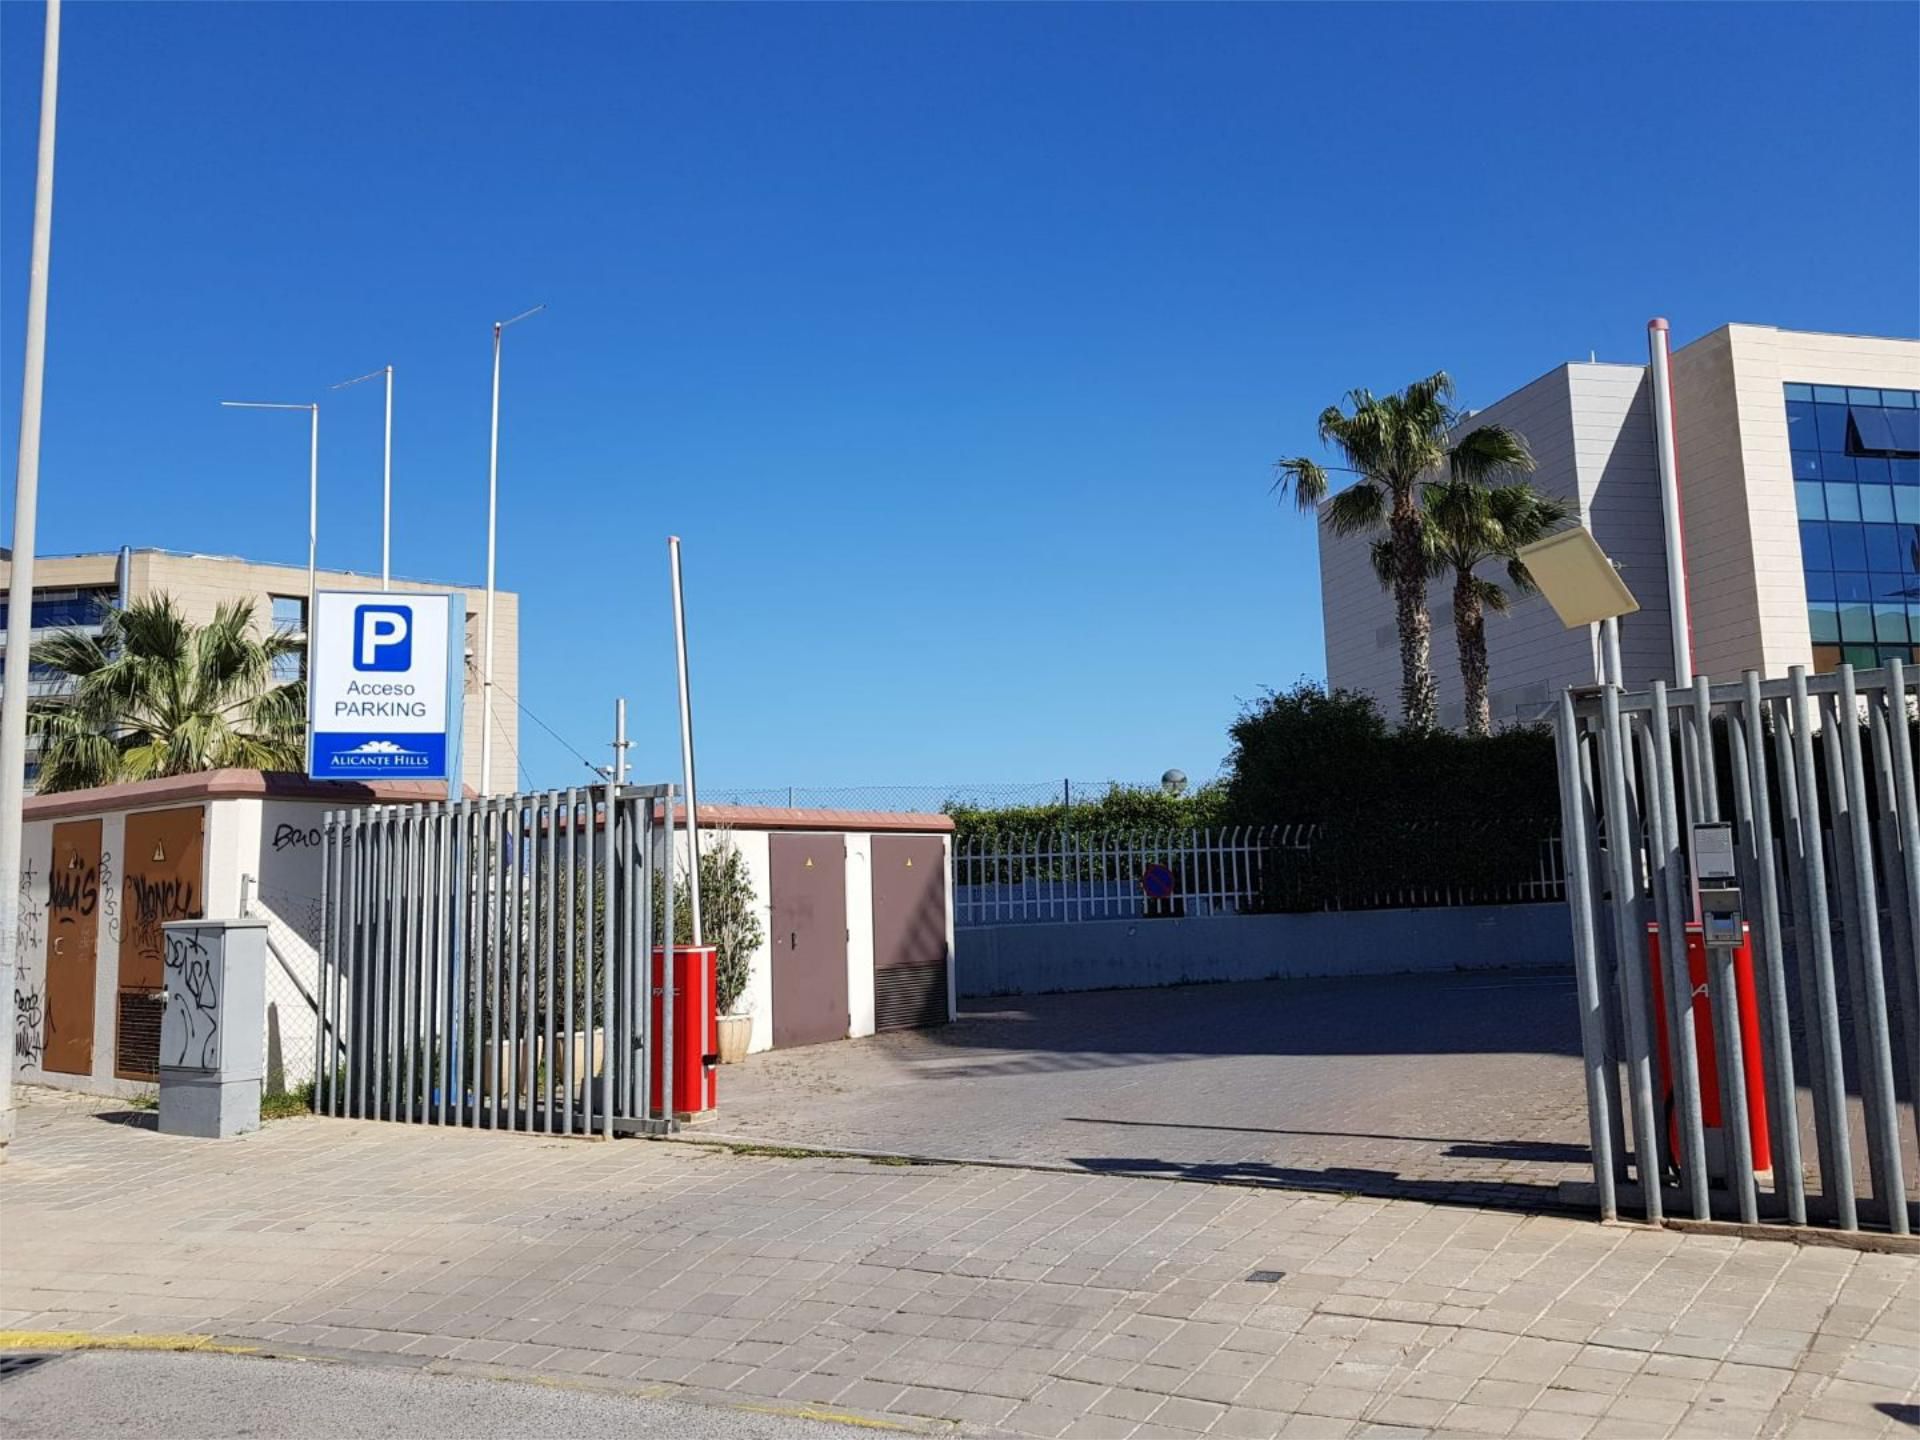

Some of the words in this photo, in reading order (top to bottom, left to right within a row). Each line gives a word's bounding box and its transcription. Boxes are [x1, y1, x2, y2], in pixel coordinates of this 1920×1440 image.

[362, 611, 408, 664] P
[346, 680, 416, 696] Acceso
[334, 701, 427, 717] PARKING
[331, 756, 391, 766] ALICANTE
[394, 755, 429, 766] HILLS
